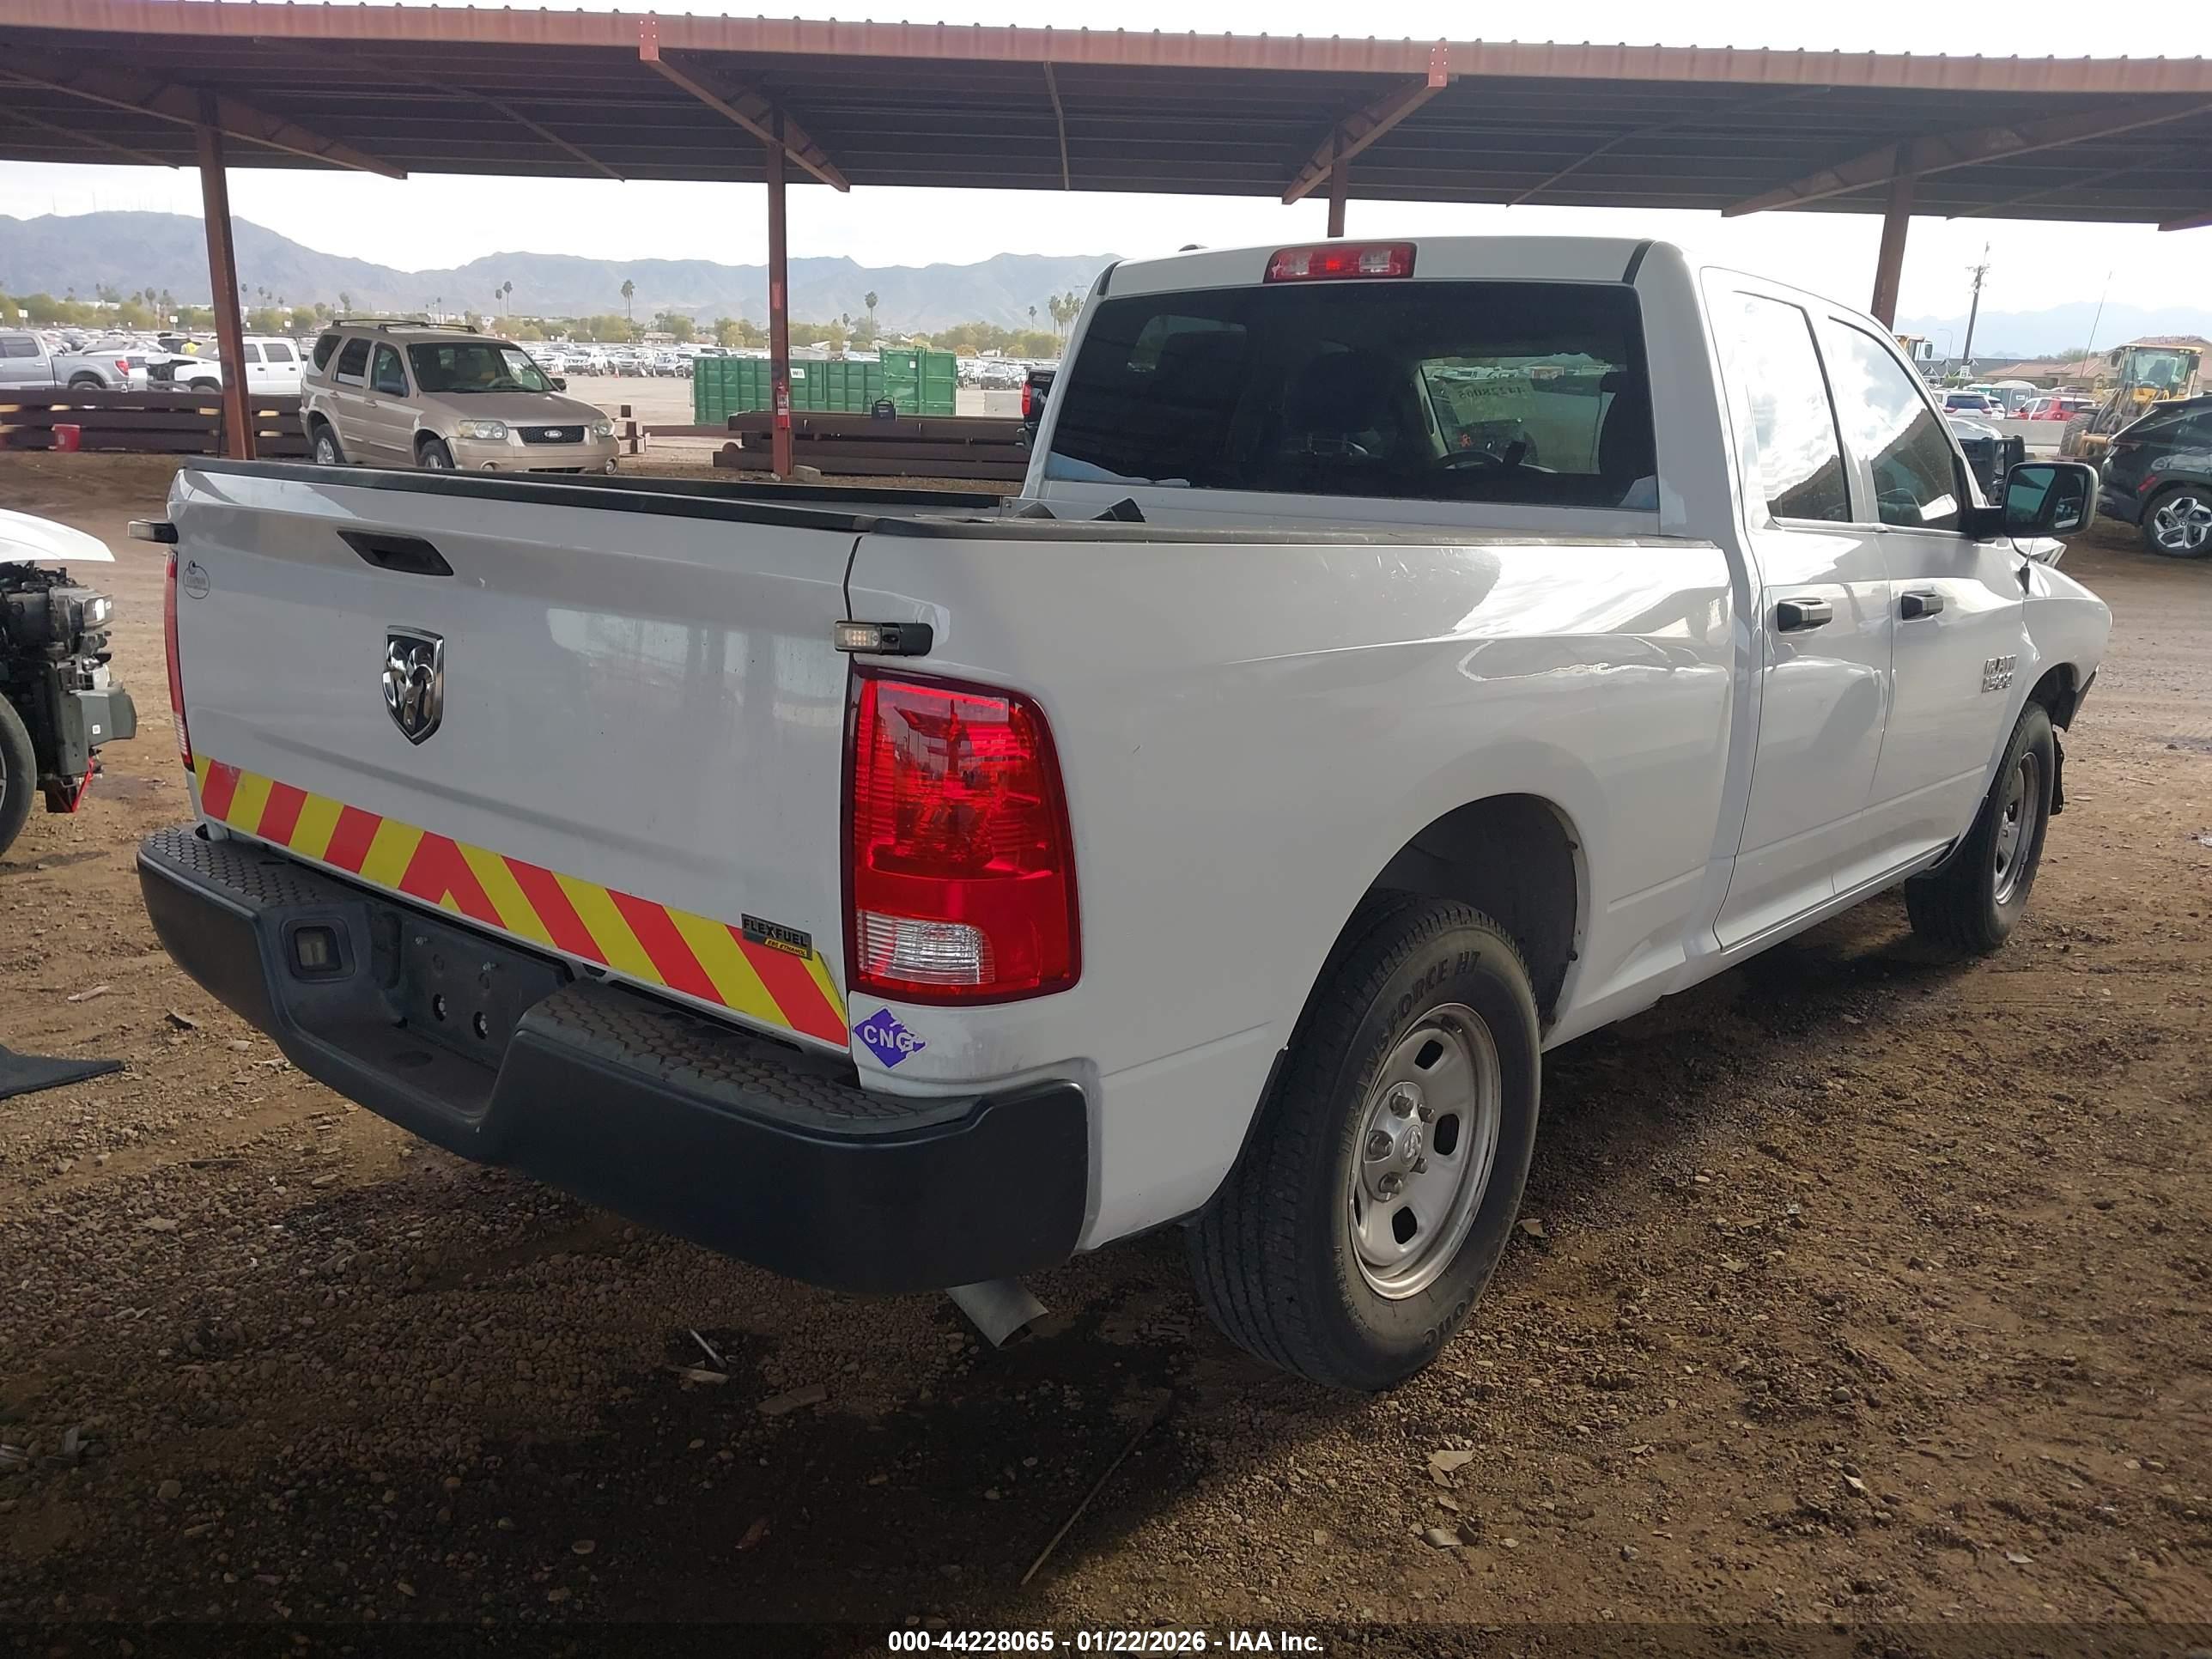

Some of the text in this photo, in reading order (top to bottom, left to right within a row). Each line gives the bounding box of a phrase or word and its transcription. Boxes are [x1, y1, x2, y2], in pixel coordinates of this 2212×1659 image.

[1984, 654, 2017, 675] RAM
[1981, 672, 2013, 694] 1500
[743, 918, 808, 947] FLEXFUEL
[779, 944, 805, 956] ETHANOL
[1454, 950, 1481, 976] HT
[864, 1024, 914, 1053] CNG
